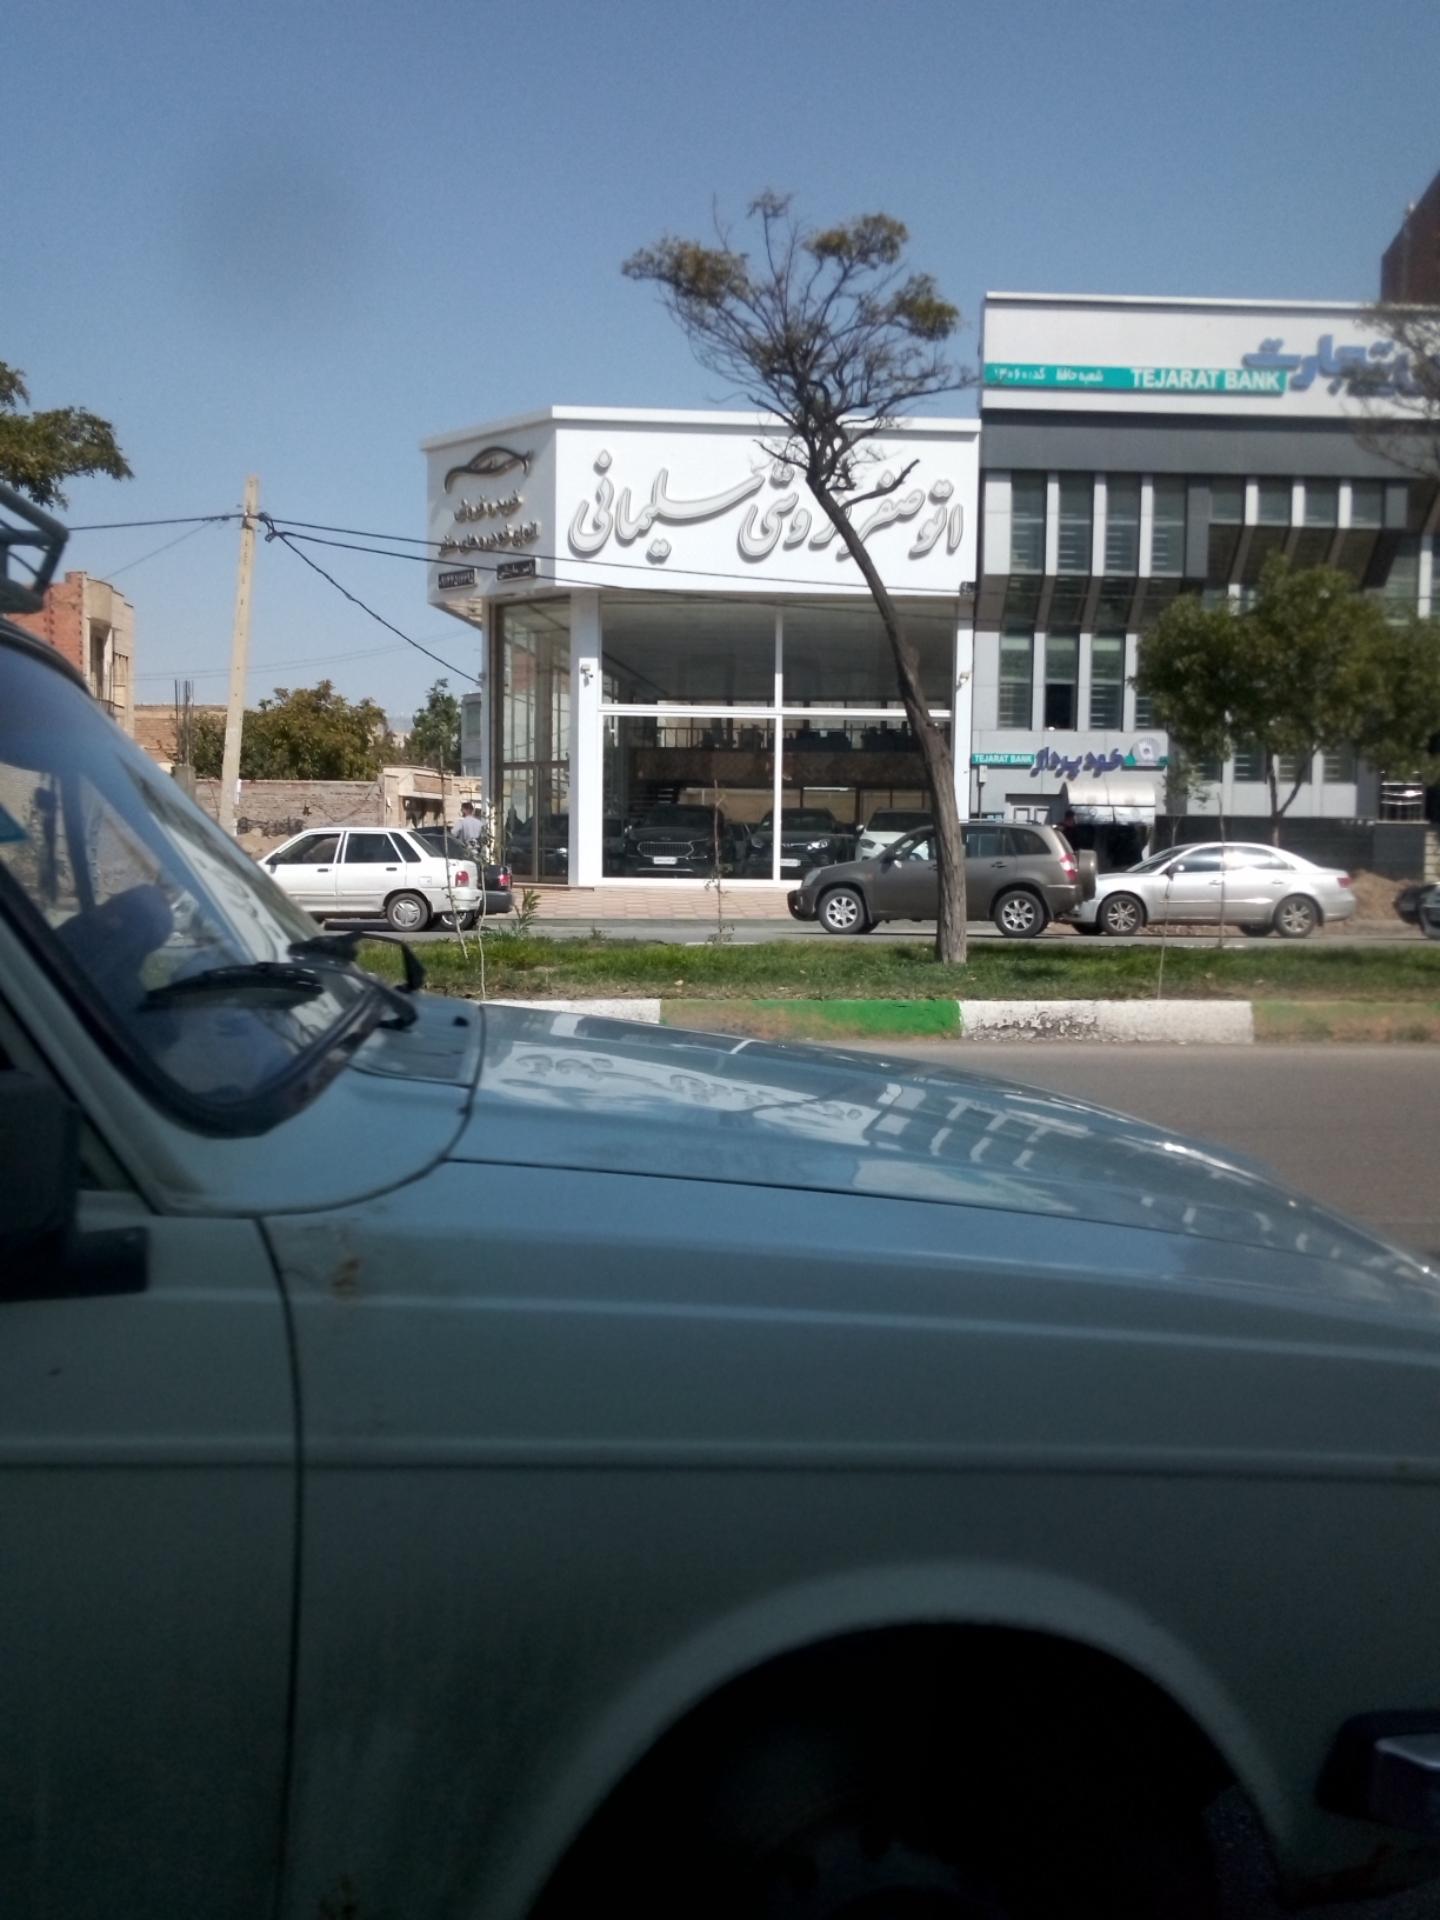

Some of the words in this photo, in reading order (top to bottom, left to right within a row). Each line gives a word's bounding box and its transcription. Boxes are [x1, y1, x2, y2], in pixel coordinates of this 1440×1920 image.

[1130, 369, 1220, 391] TEJARAT
[1224, 370, 1281, 392] BANK
[570, 449, 766, 562] سلیمانی
[908, 480, 964, 557] اتو
[974, 754, 1009, 764] TEJARAT
[1010, 754, 1032, 764] BANK
